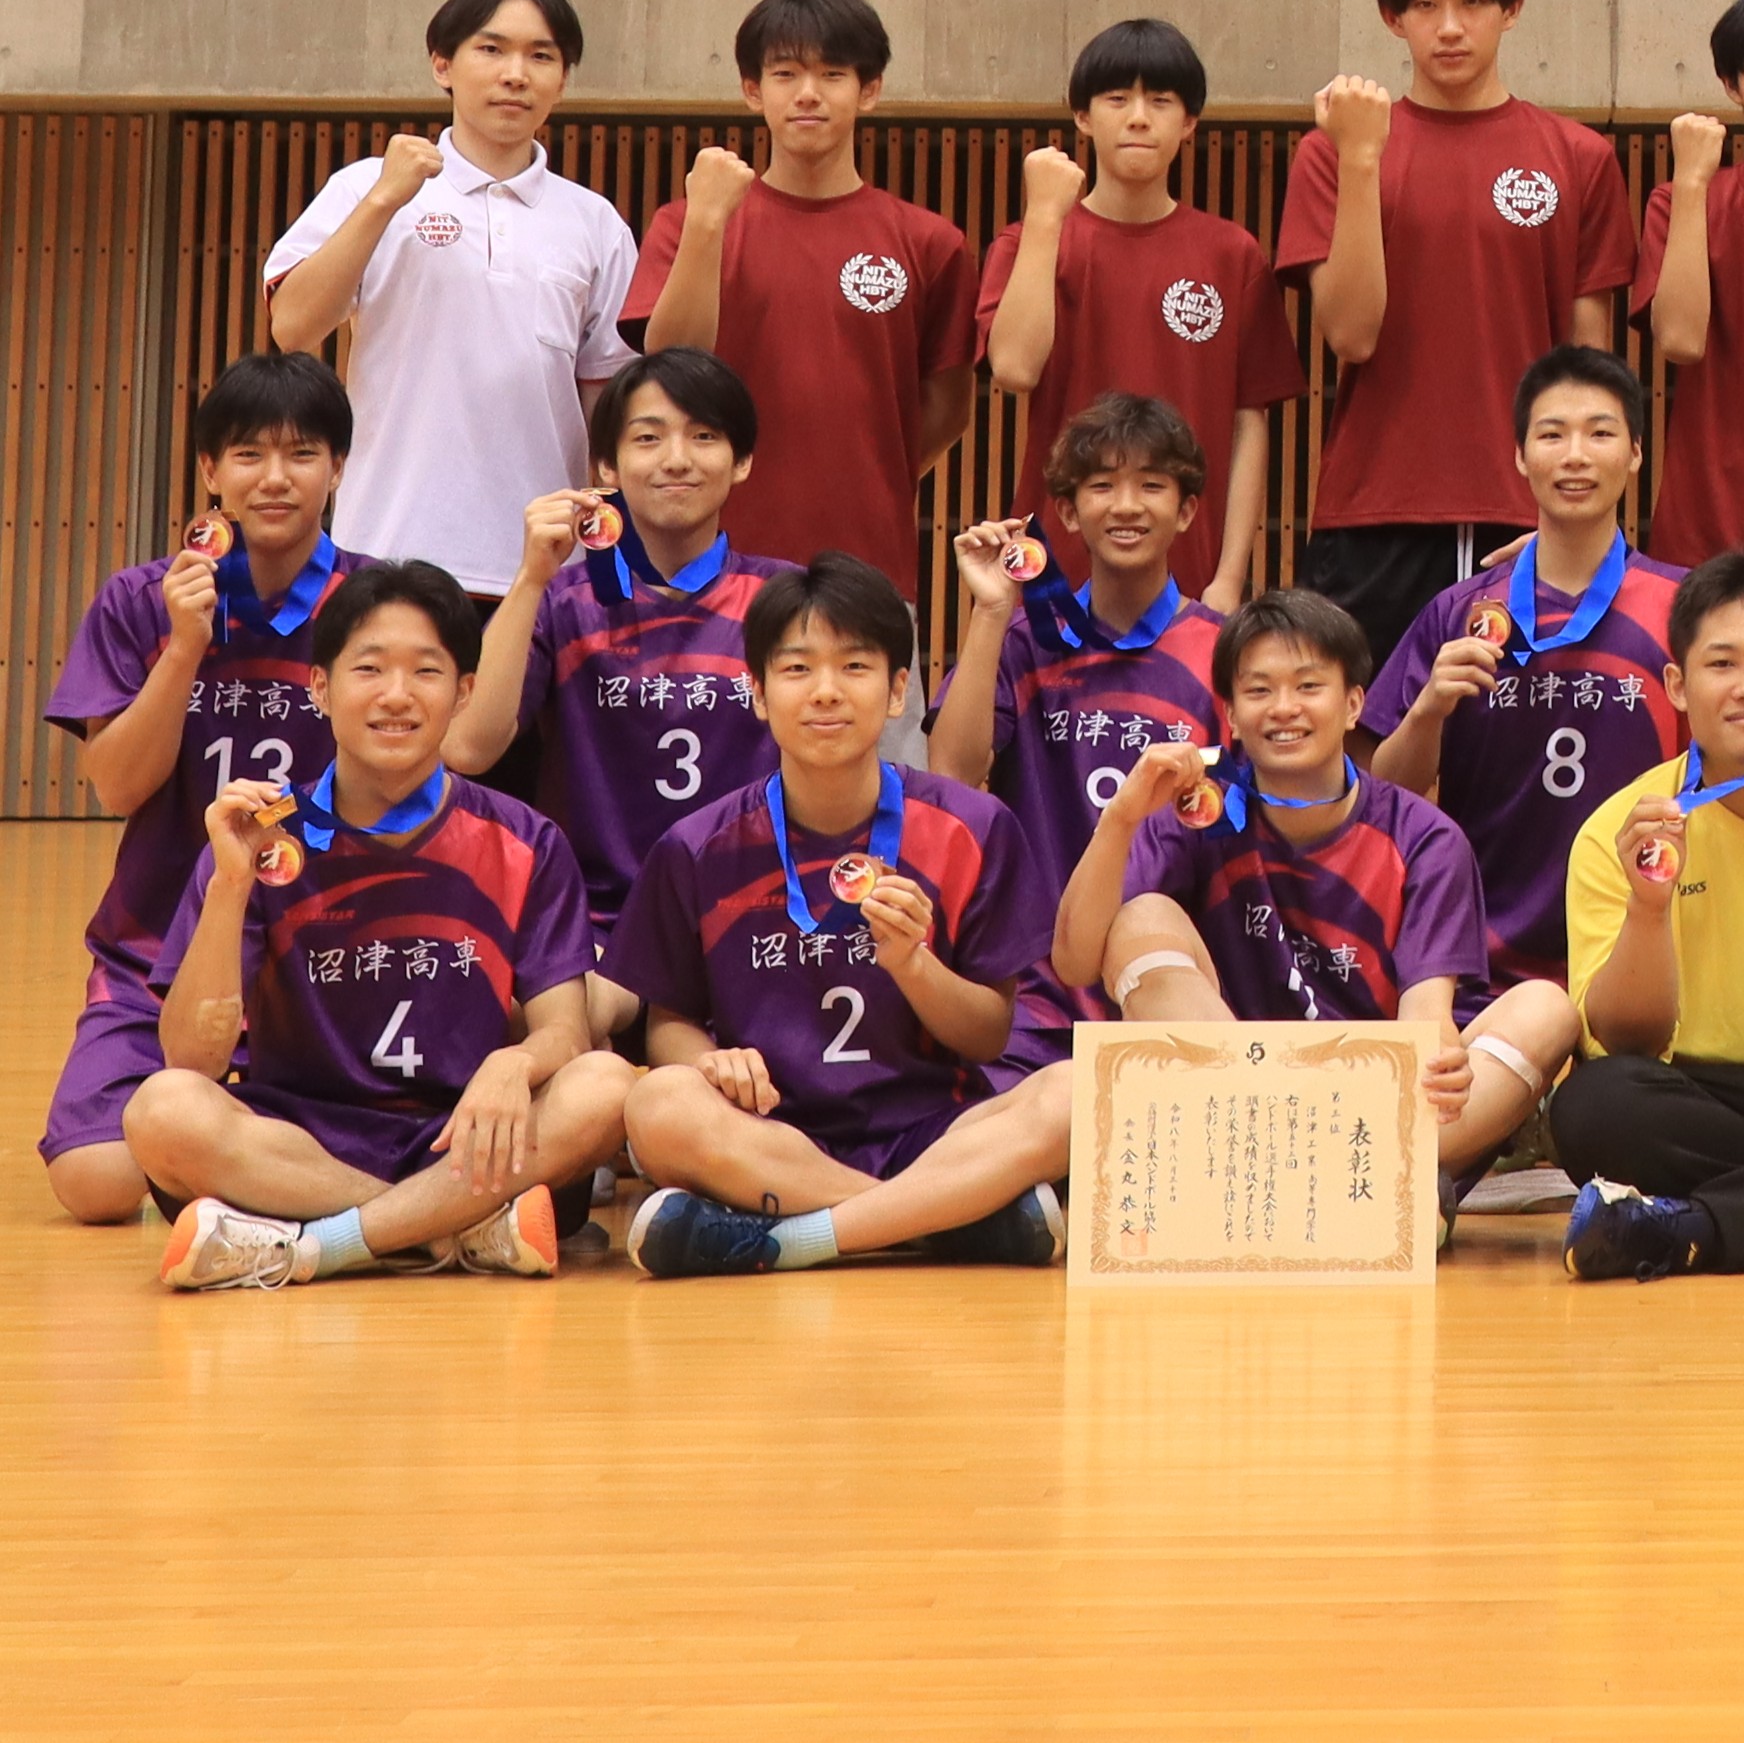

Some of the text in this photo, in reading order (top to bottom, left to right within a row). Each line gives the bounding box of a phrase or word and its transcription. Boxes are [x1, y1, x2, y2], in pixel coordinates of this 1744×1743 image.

[1499, 187, 1553, 202] NUMAZU
[1514, 180, 1539, 190] NIT
[845, 272, 902, 289] NUMAZU
[863, 265, 889, 276] NIT
[1184, 292, 1208, 305] NIT
[597, 672, 754, 710] 沼津高専
[1489, 672, 1647, 712] 沼津高専
[1043, 709, 1193, 753] 沼津高専
[654, 728, 702, 801] 3
[1542, 727, 1587, 797] 8
[308, 936, 482, 984] 沼津高専
[751, 924, 879, 970] 沼津高
[1245, 903, 1362, 983] 沼高専
[371, 1000, 424, 1077] 4
[820, 985, 871, 1063] 2
[1348, 1117, 1373, 1202] 表彰状
